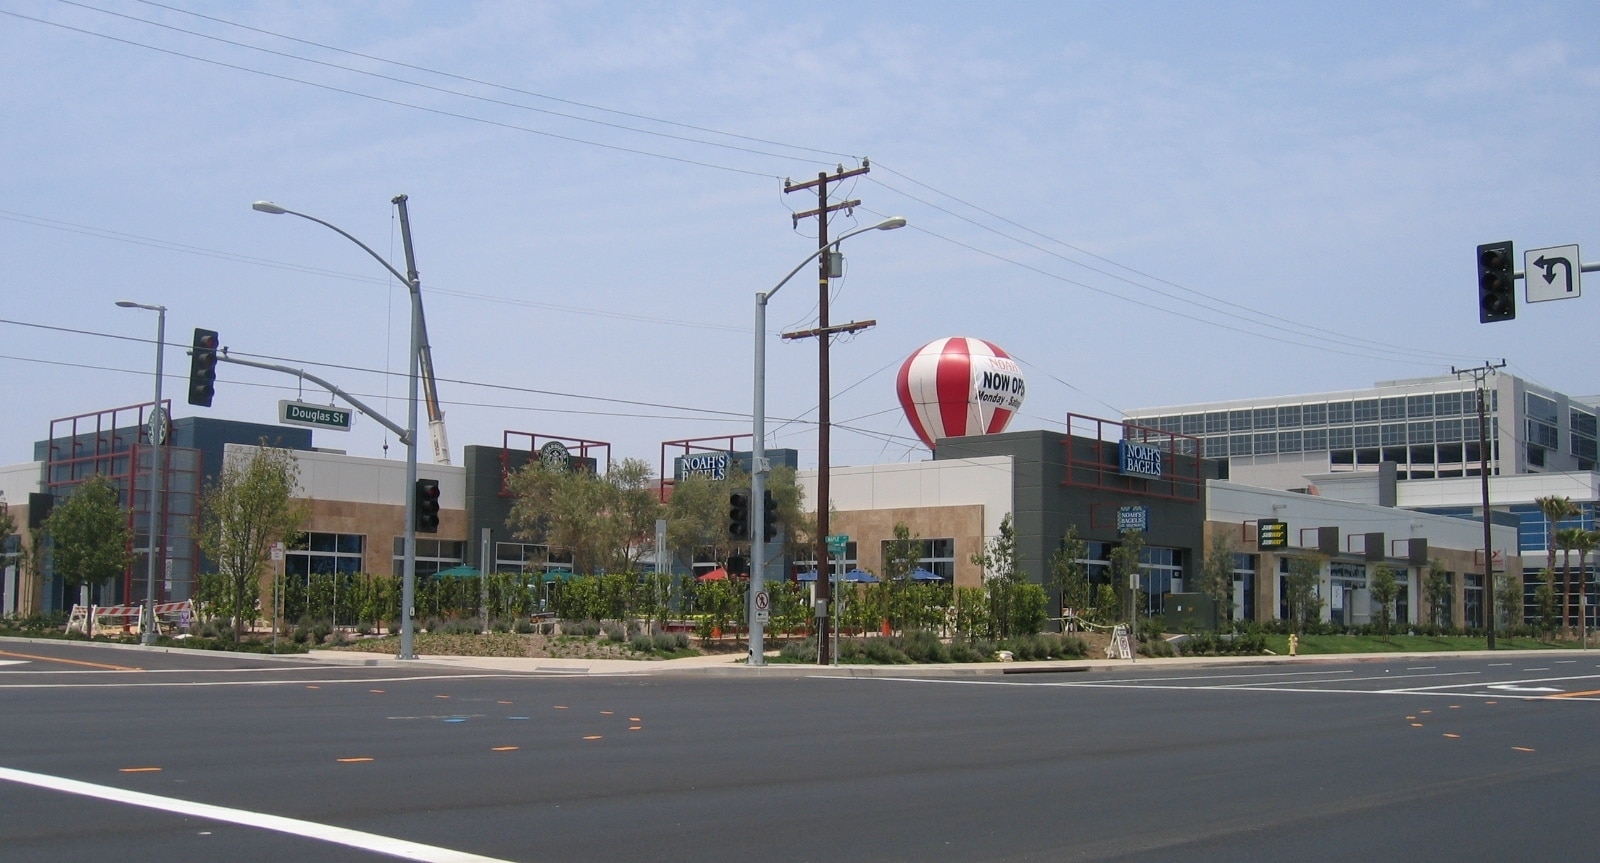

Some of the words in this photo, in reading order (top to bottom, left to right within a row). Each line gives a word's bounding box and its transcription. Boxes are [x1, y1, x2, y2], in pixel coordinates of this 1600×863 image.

[983, 371, 1010, 392] NOW
[975, 390, 1006, 406] Monday
[292, 406, 330, 422] Douglas
[333, 412, 344, 424] St
[1127, 444, 1161, 463] NOAH'S
[682, 455, 725, 471] NOAH'S
[1127, 458, 1161, 476] BAGELS
